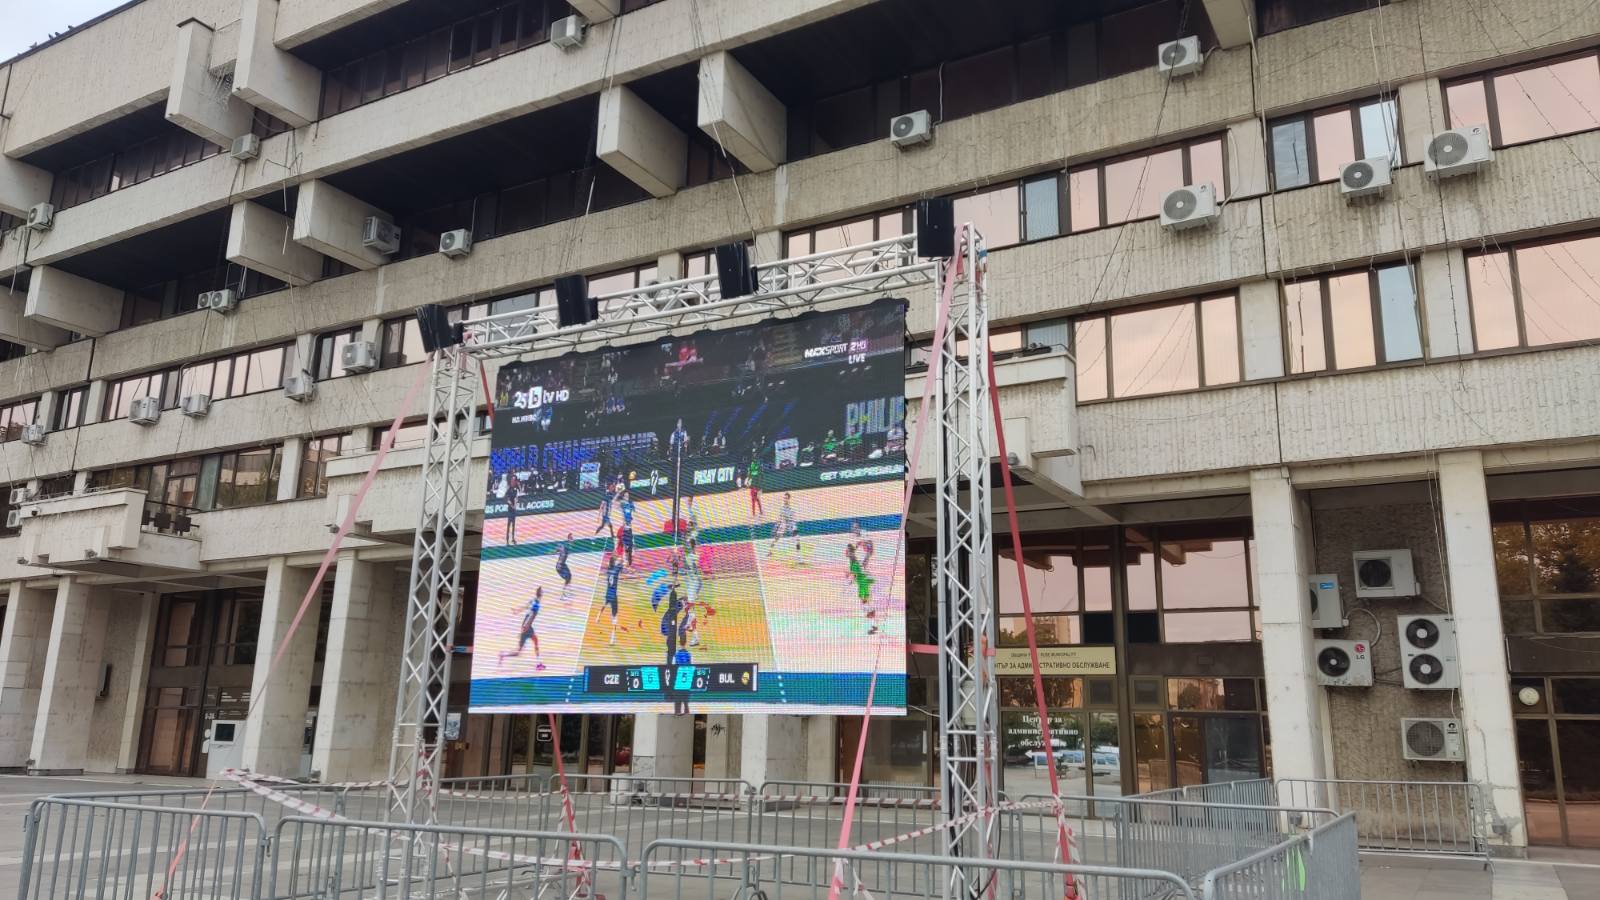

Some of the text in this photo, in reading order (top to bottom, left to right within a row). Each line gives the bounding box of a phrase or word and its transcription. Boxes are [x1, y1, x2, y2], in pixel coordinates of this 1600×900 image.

[849, 354, 865, 364] LIVE
[556, 389, 569, 402] HD
[718, 466, 735, 482] CITY
[526, 499, 554, 510] ACCESS
[604, 674, 620, 685] CZE
[632, 678, 639, 689] 0
[696, 677, 703, 688] 0
[719, 673, 735, 684] BUL
